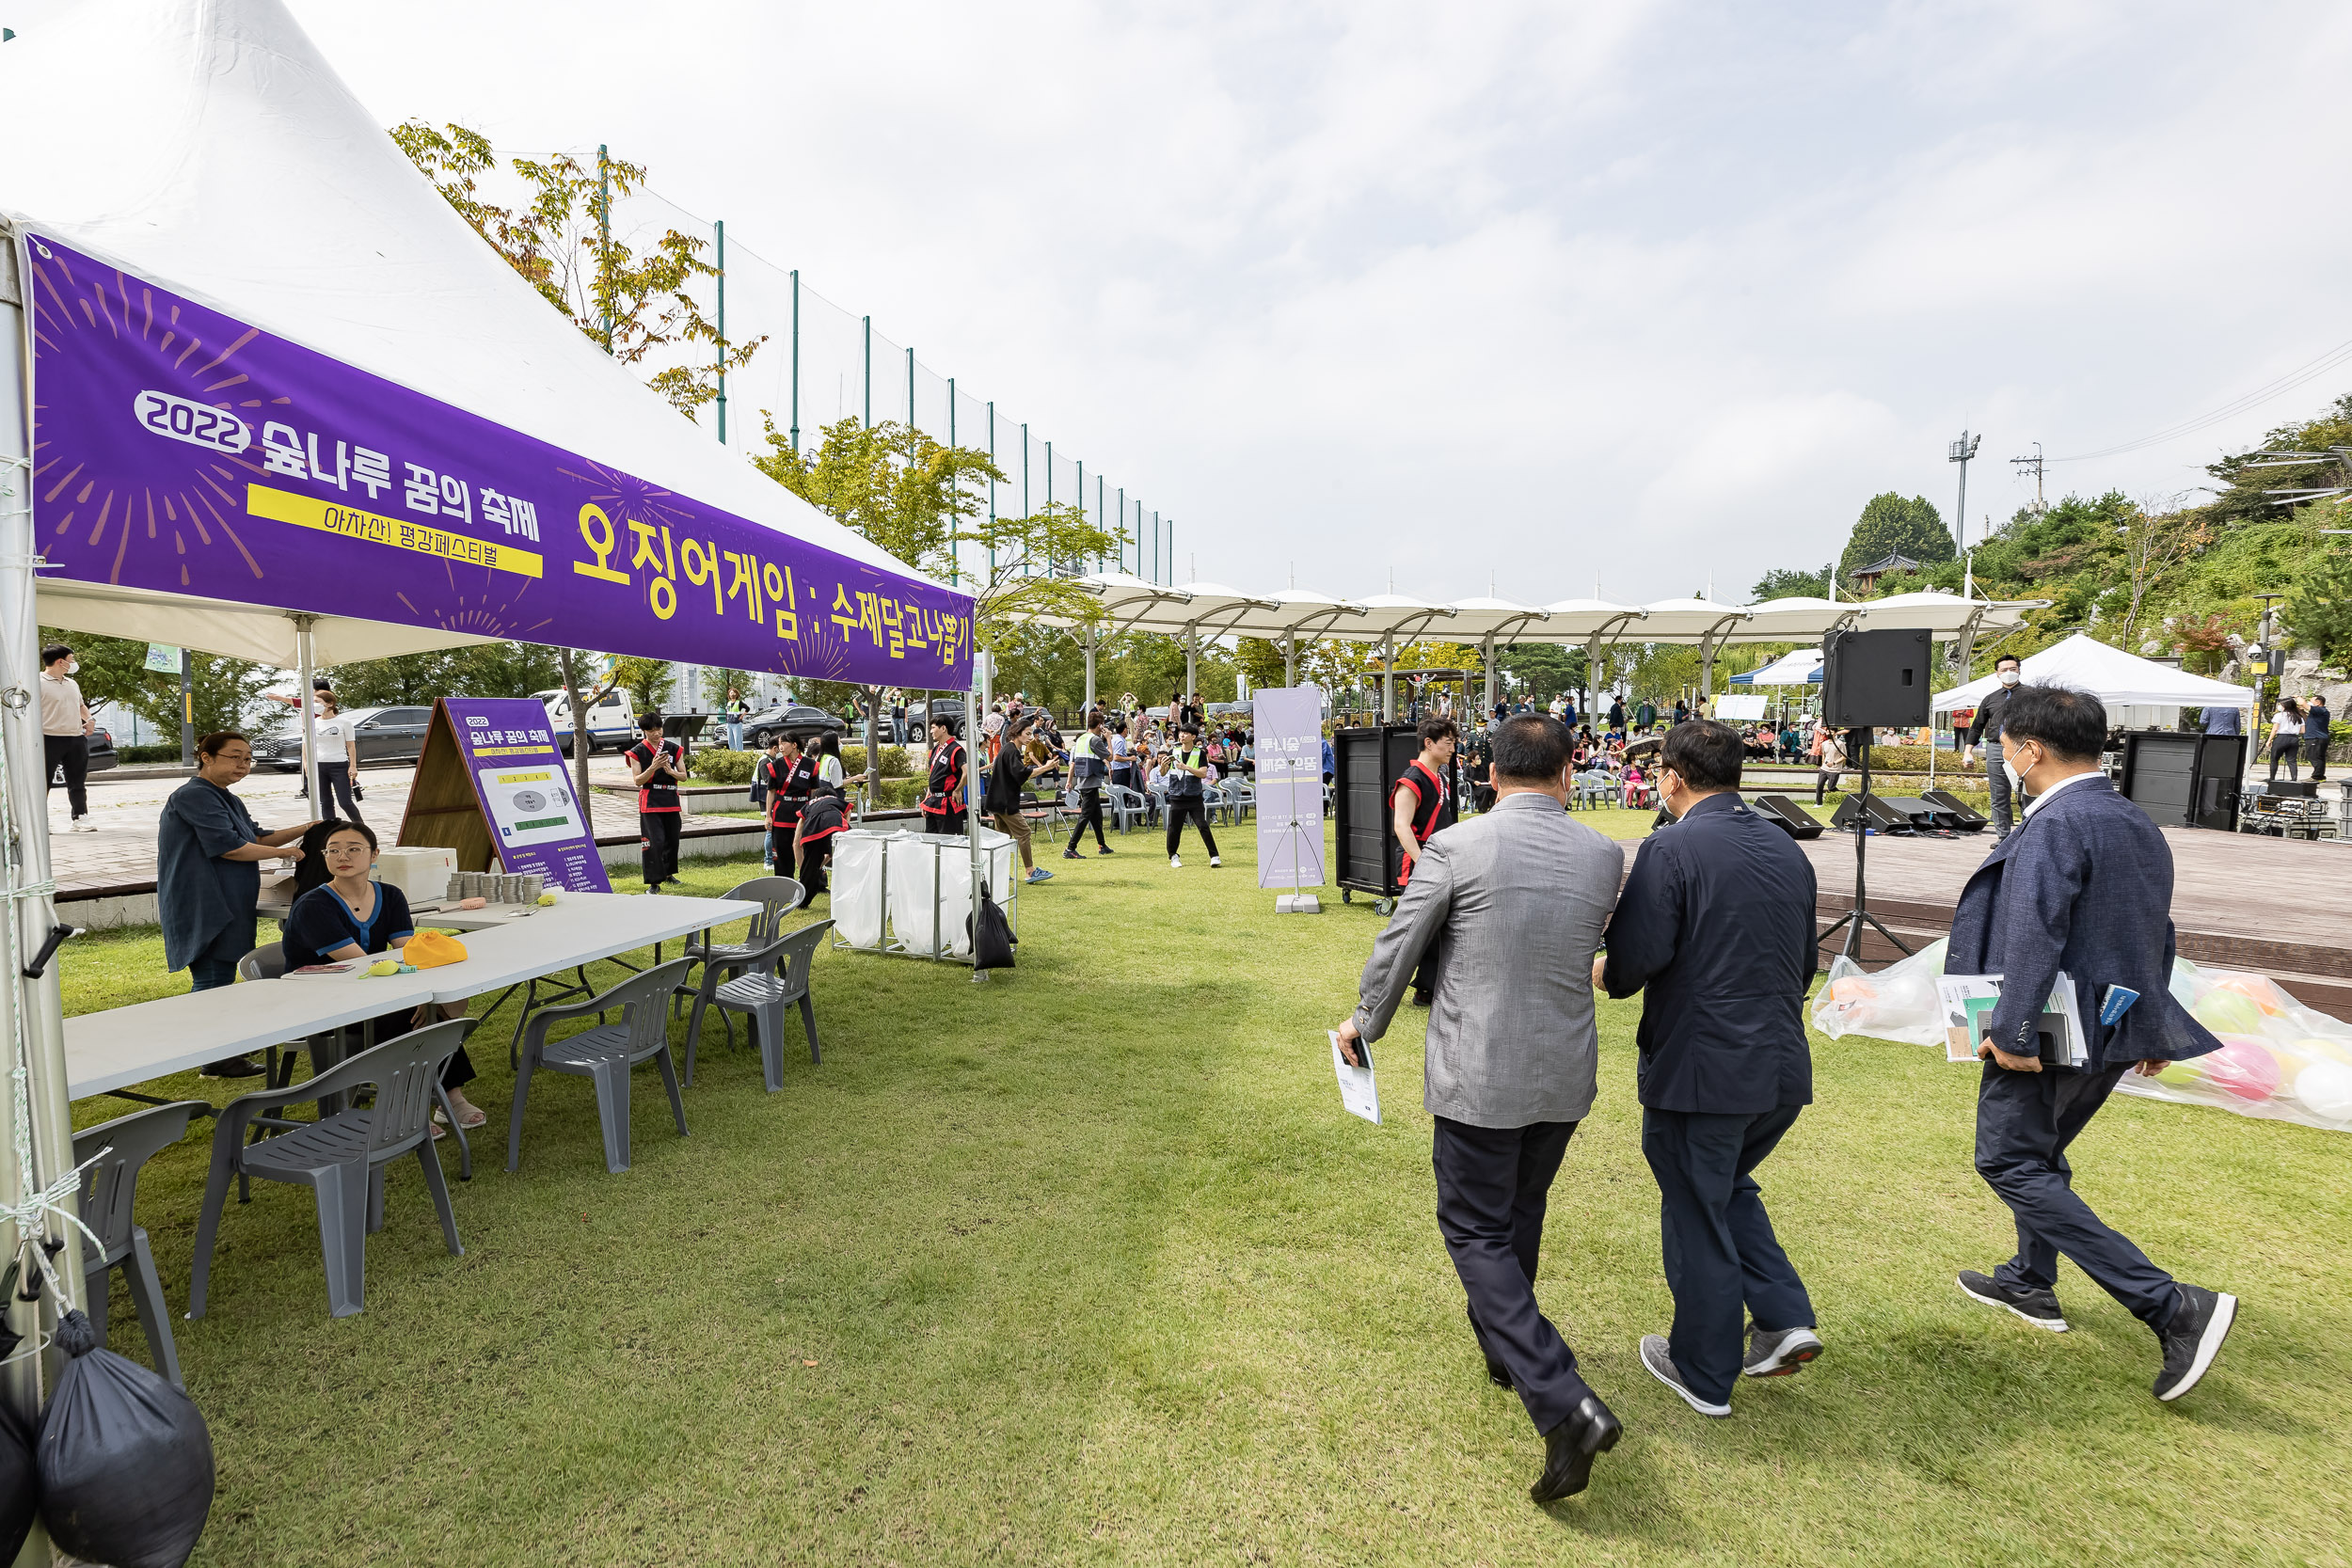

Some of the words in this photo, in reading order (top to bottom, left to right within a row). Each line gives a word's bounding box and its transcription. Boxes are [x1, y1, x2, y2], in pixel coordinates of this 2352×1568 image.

[145, 395, 241, 450] 2022
[262, 420, 391, 499] 숲나루
[404, 461, 472, 524] 꿈의
[481, 487, 541, 543] 축제
[324, 506, 391, 543] 아차산!
[400, 524, 498, 566] 평강페스티벌
[573, 501, 798, 641] 오징어게임
[831, 582, 969, 666] 수제달고나뽑기
[470, 731, 504, 745] 숲나루
[504, 730, 529, 744] 꿈의
[528, 729, 549, 743] 축제
[786, 757, 802, 783] EXTREME
